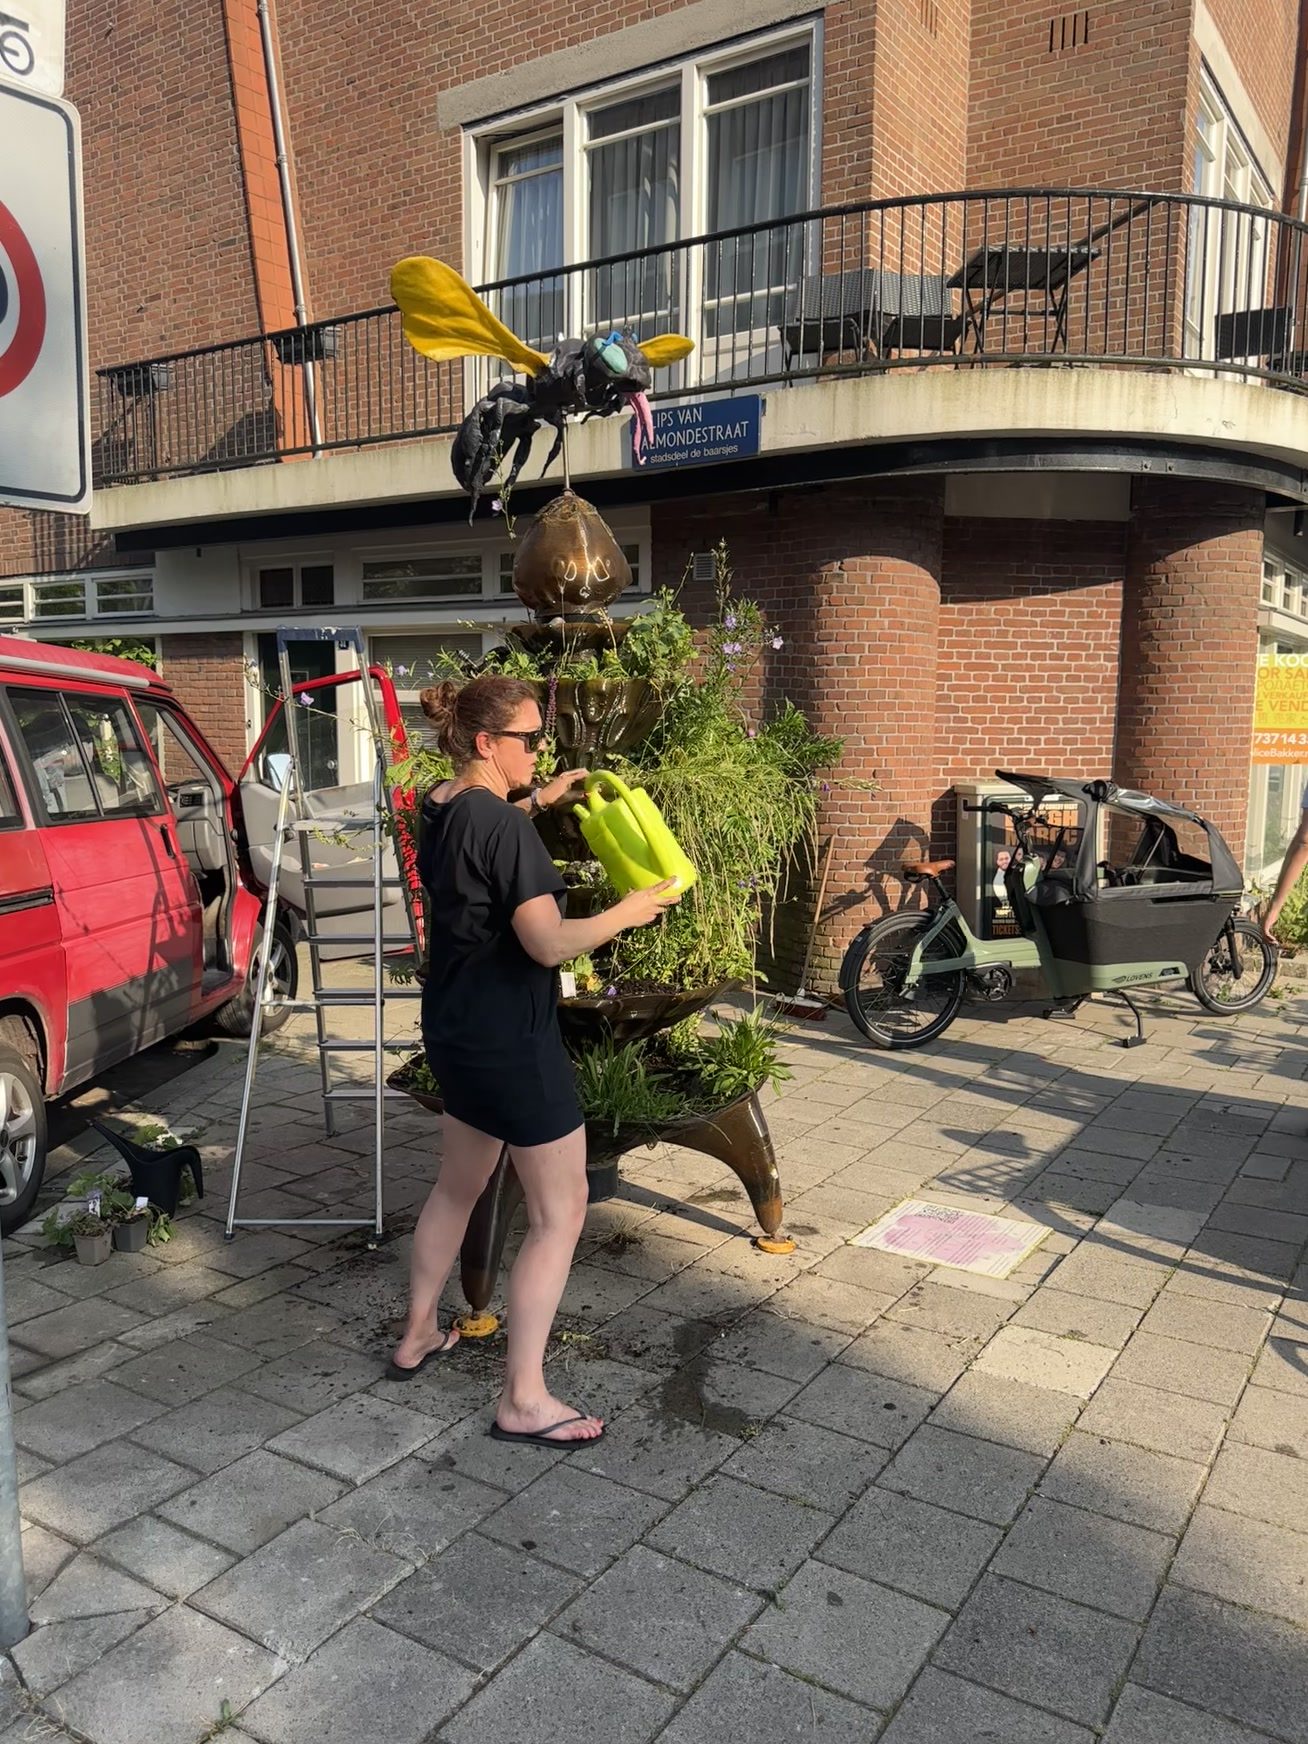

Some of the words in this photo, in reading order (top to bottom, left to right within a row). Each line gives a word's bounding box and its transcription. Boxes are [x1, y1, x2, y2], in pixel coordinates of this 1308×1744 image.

[677, 407, 702, 424] VAN
[650, 450, 688, 463] stadsdeel
[690, 448, 700, 458] de
[704, 444, 738, 456] baarsjes
[1285, 667, 1308, 680] SA
[1126, 972, 1153, 982] LOVENS
